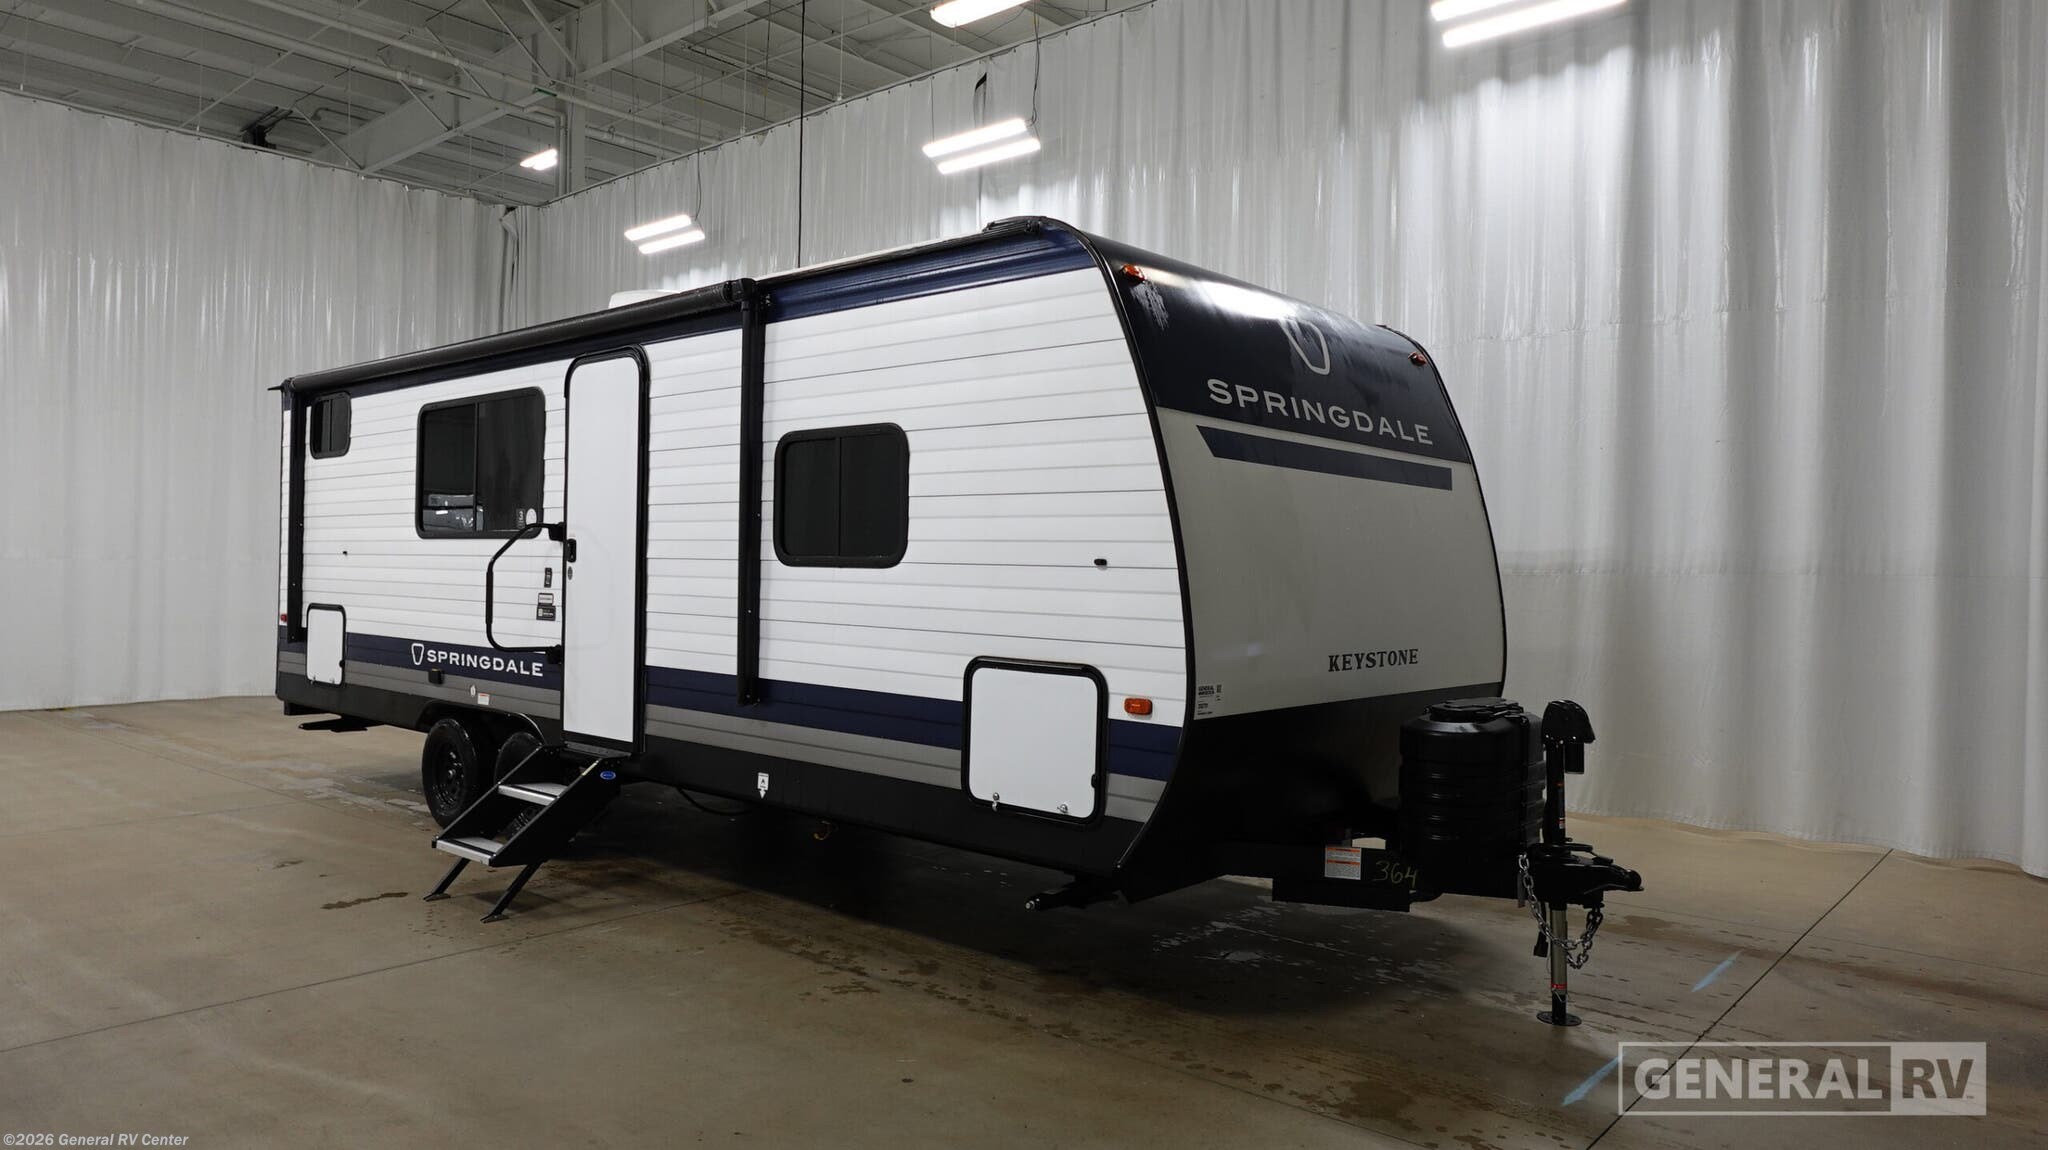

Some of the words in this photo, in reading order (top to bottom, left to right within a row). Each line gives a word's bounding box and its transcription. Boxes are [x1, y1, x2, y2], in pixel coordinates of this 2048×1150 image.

[1207, 378, 1433, 445] SPRINGDALE
[427, 649, 543, 677] SPRINGDALE
[1328, 648, 1418, 672] KEYSTONE
[1374, 860, 1418, 888] 364
